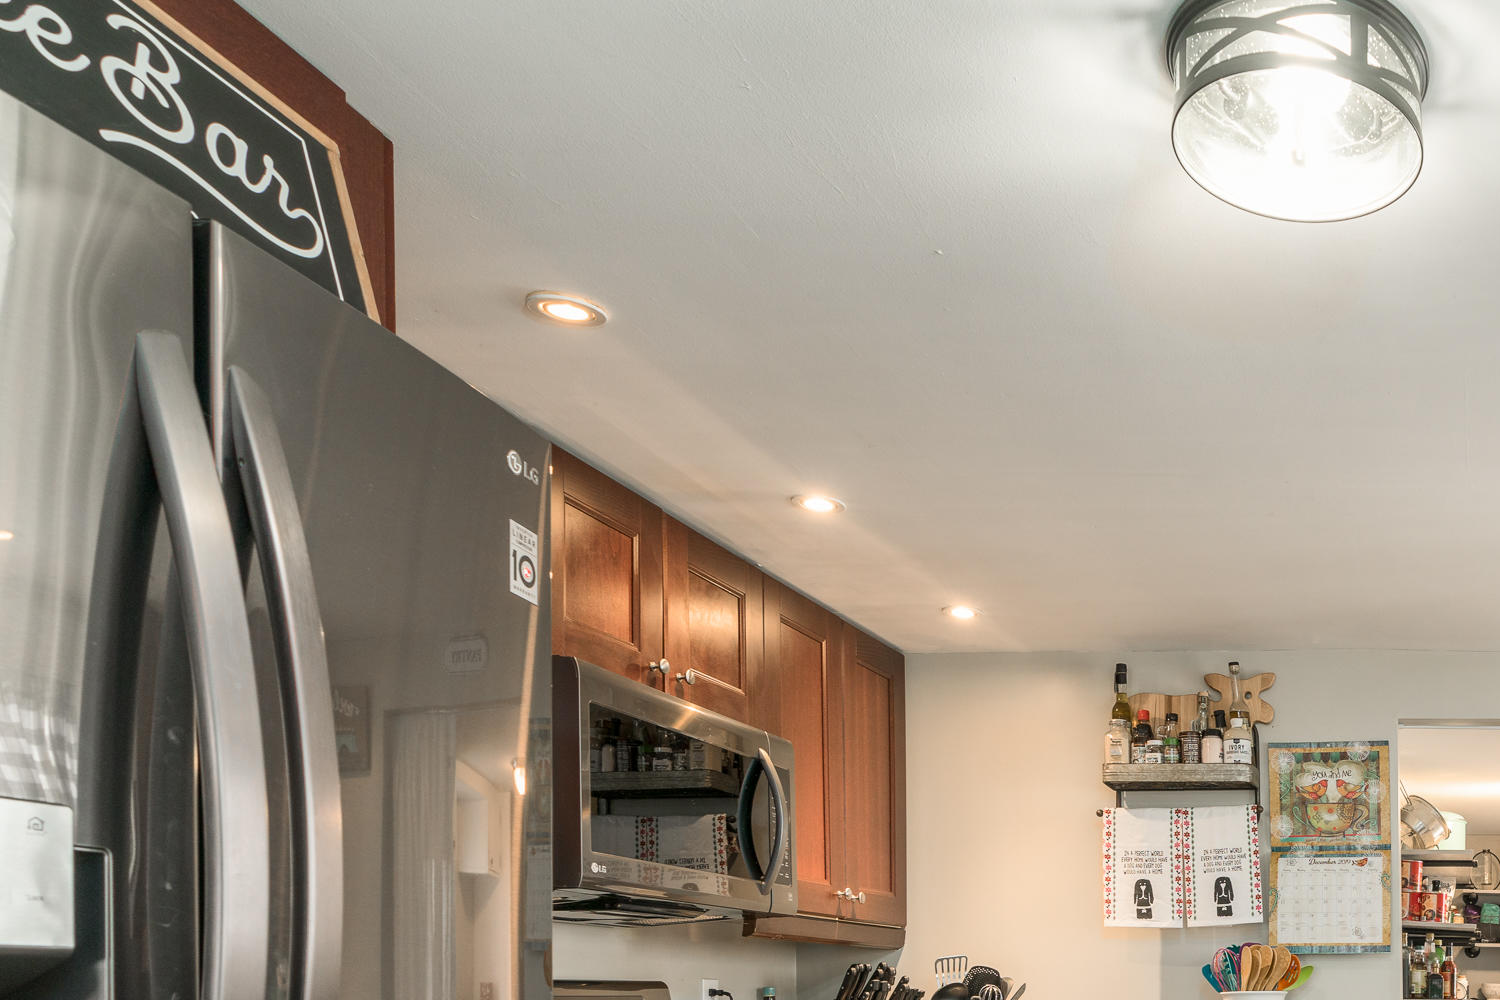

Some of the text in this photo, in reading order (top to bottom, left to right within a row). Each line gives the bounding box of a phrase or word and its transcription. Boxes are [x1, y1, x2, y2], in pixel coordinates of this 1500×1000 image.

[100, 13, 324, 258] Bar
[511, 548, 536, 589] 10
[1308, 857, 1337, 866] December
